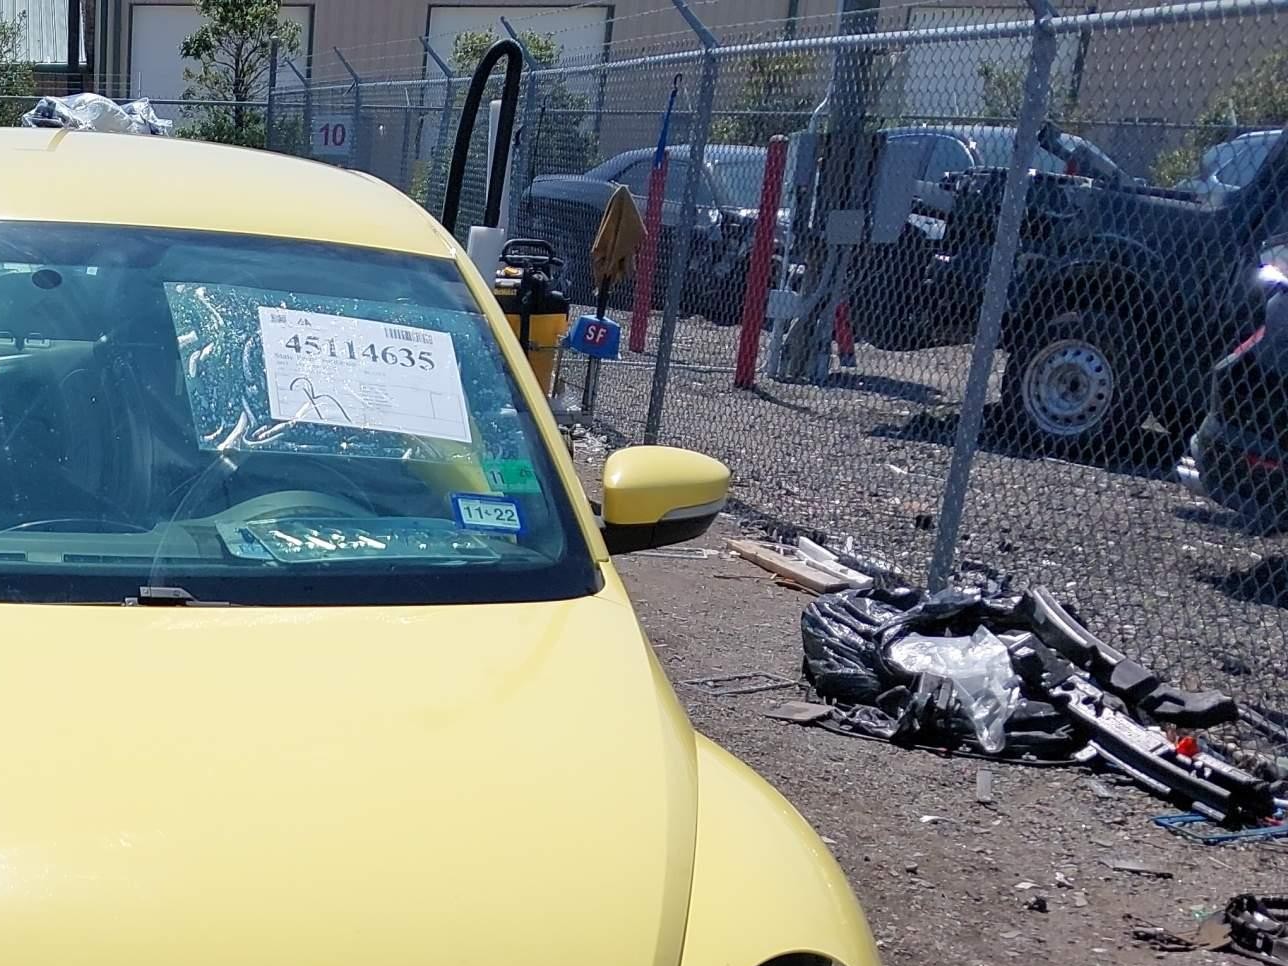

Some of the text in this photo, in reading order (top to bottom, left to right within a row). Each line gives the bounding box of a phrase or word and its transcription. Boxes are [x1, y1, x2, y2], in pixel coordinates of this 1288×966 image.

[319, 123, 346, 147] 10
[585, 325, 608, 343] SF
[284, 333, 436, 372] 45114635
